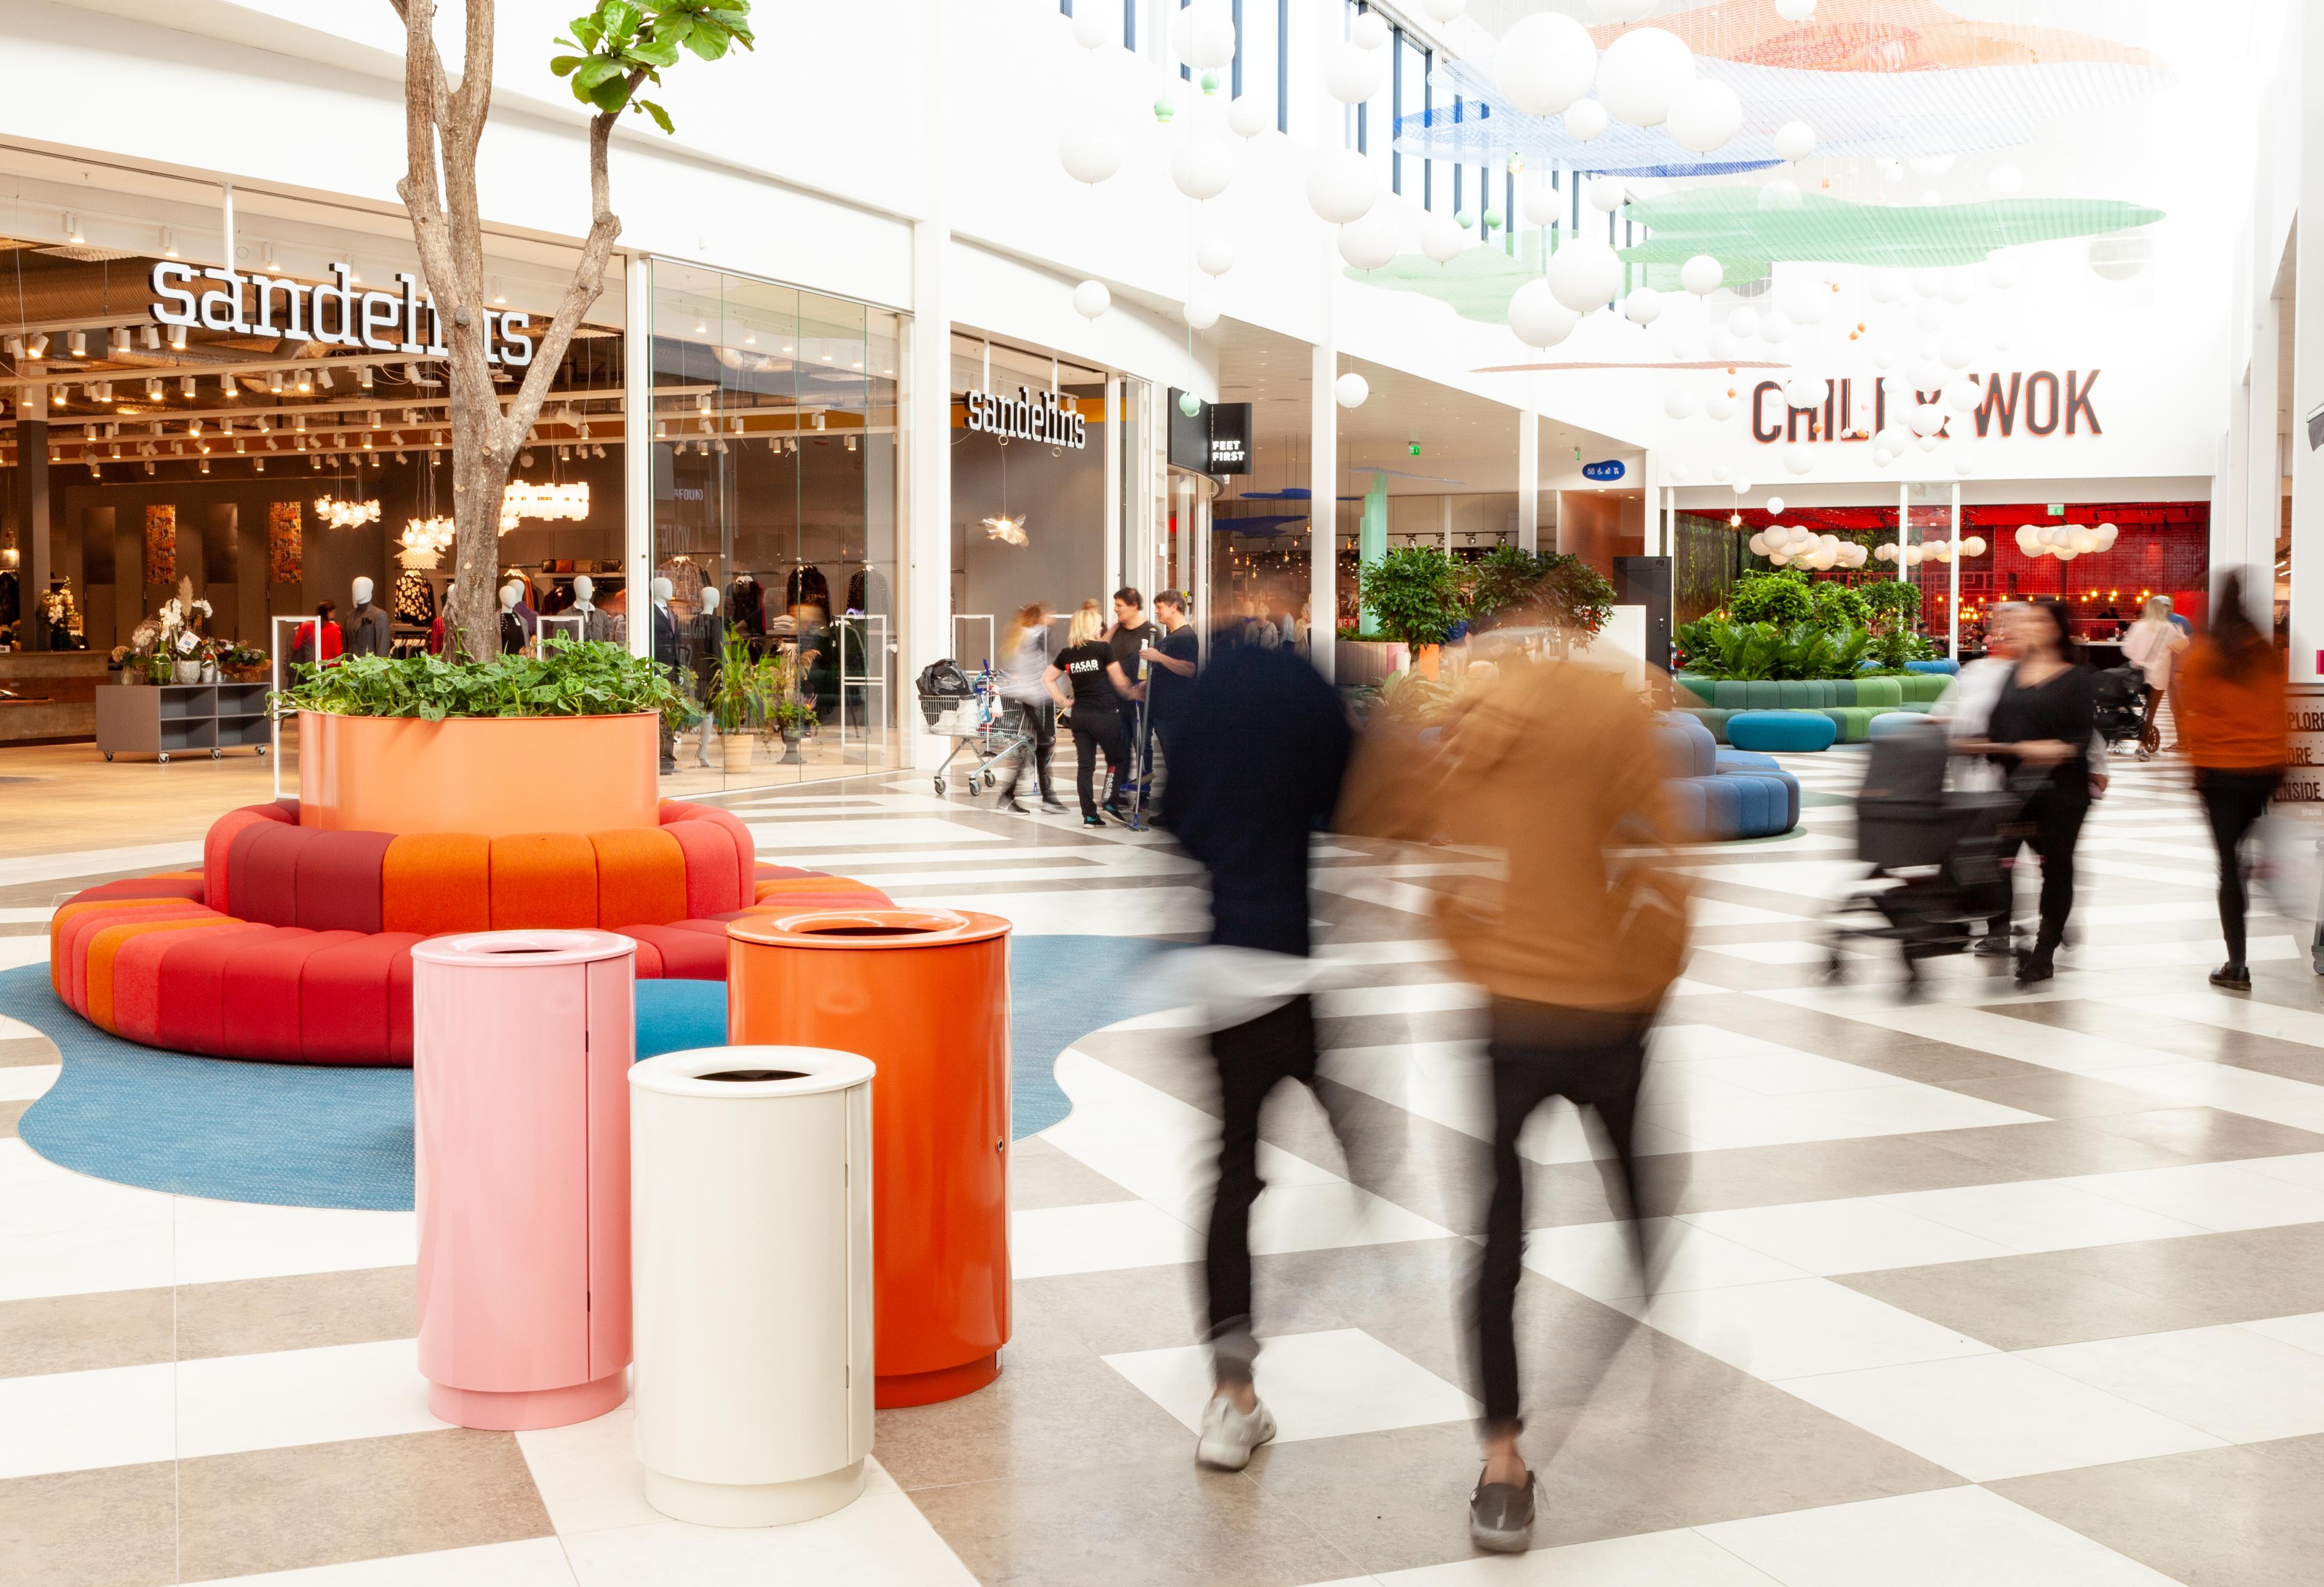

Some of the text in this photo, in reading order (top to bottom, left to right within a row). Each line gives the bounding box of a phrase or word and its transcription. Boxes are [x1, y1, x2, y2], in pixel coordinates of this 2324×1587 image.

[151, 261, 533, 366] sandelis
[968, 386, 1086, 450] sandelins
[1969, 369, 2102, 438] WOK
[1212, 441, 1241, 450] FEET
[1212, 451, 1245, 461] FIRST
[1070, 660, 1098, 671] FASAB
